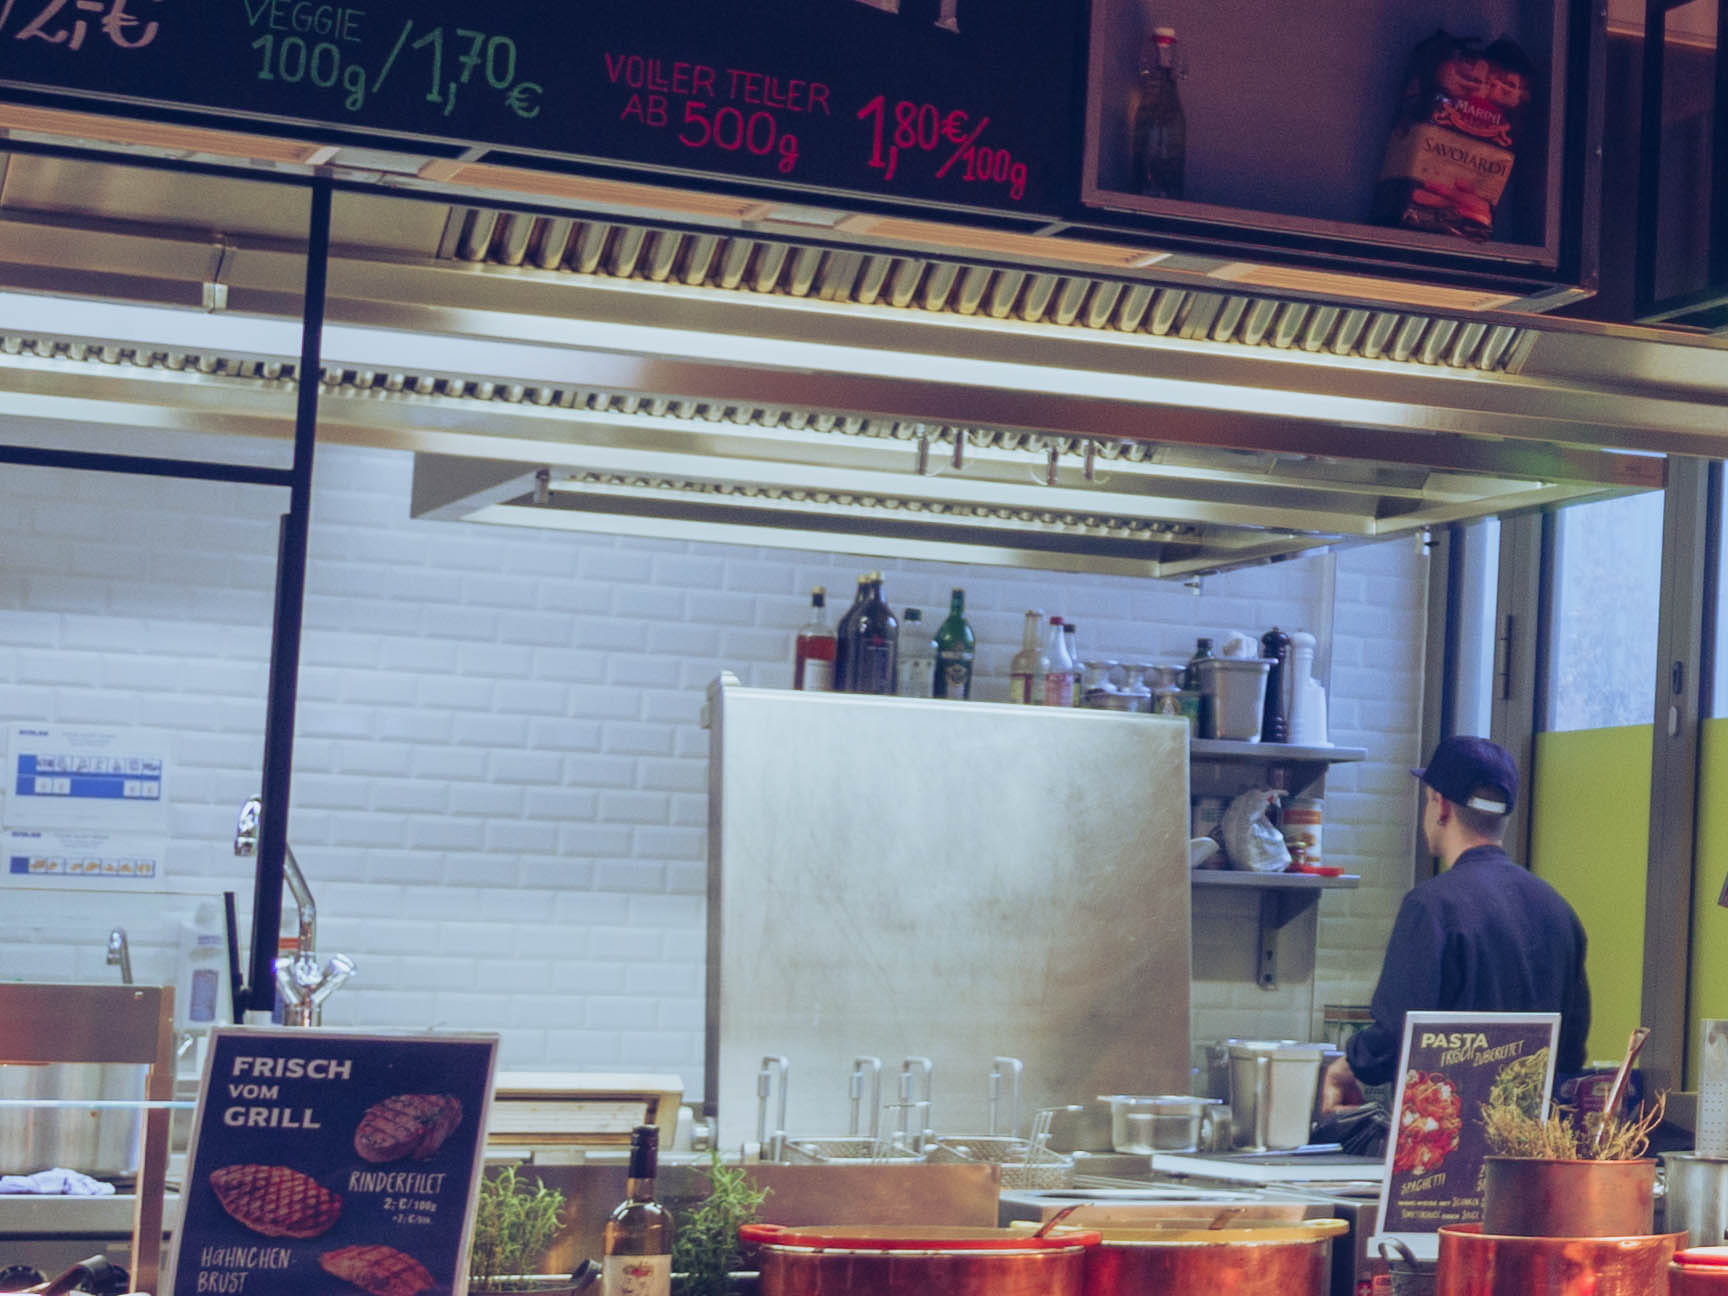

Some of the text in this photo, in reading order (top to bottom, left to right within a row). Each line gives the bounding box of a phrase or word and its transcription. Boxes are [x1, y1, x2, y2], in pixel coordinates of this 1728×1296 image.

[604, 52, 831, 117] VOLLER TELLER
[620, 94, 799, 174] AB 500g
[1420, 1032, 1489, 1049] PASTA
[231, 1055, 354, 1081] FRISCH
[226, 1083, 281, 1100] VOM
[223, 1105, 323, 1130] GRILL
[348, 1170, 448, 1194] RINDERFILET
[196, 1270, 249, 1294] BRUST
